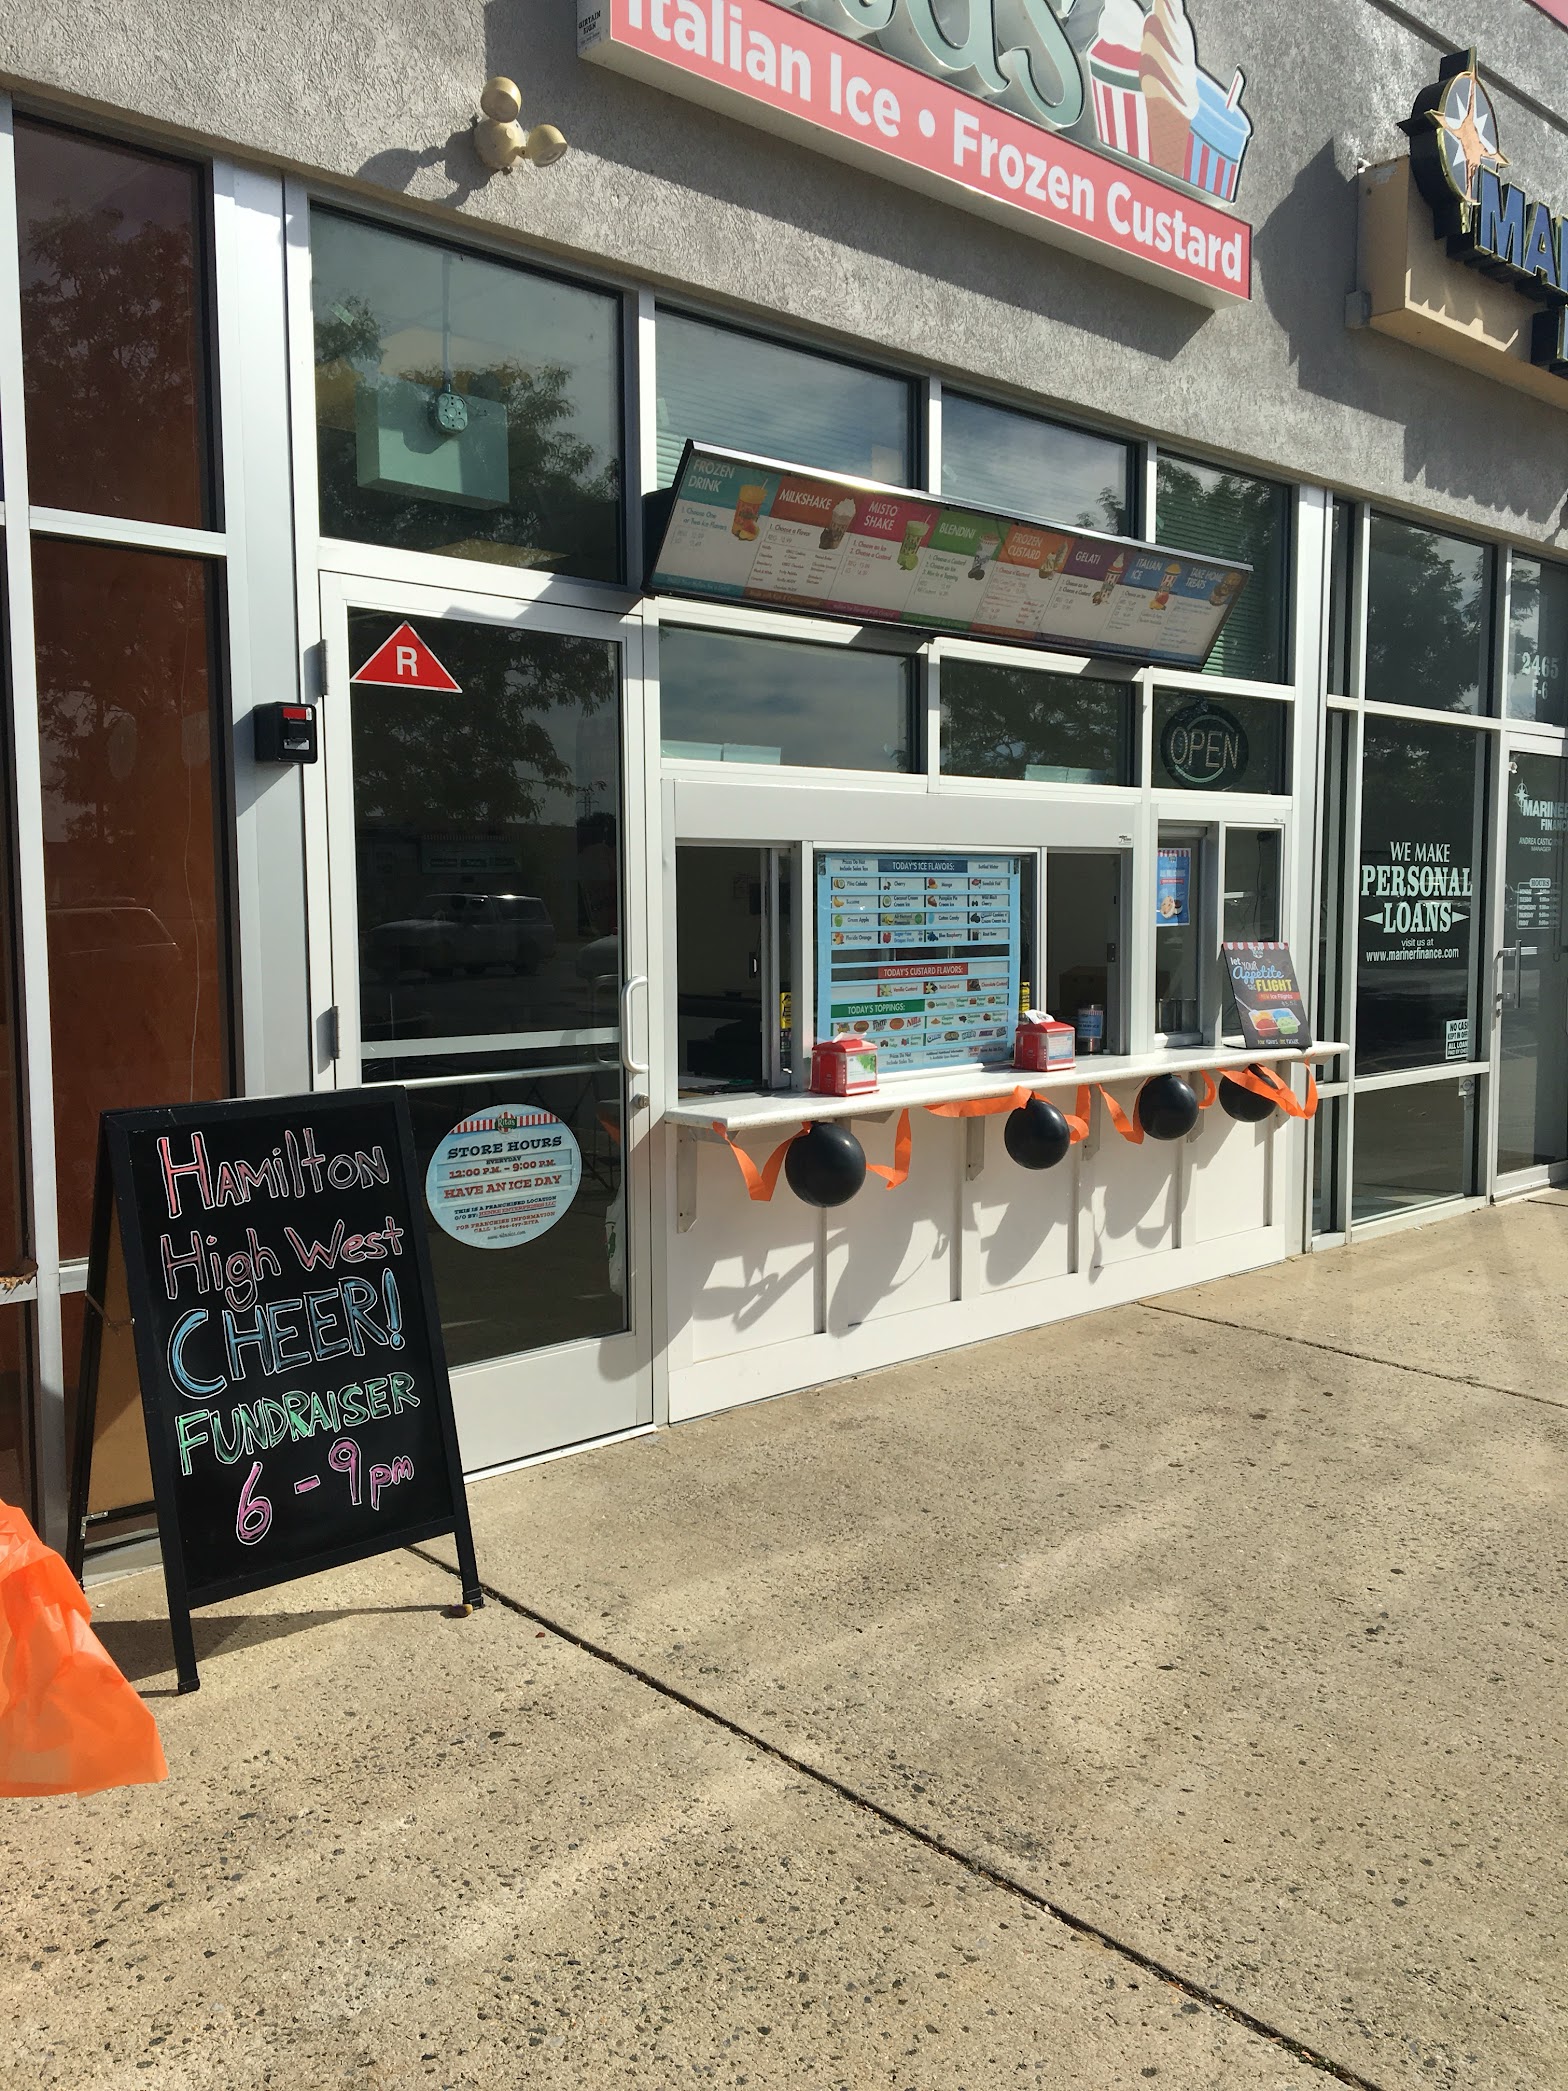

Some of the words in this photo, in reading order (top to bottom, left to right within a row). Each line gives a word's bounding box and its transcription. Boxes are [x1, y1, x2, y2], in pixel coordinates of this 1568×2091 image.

[830, 51, 901, 138] Ice
[953, 108, 1095, 222] Frozen
[1107, 182, 1242, 283] Custard
[693, 459, 735, 479] FROZEN
[687, 475, 722, 493] DRINK
[779, 489, 832, 510] MILKSHAKE
[868, 501, 899, 517] MISTO
[774, 524, 792, 533] Choose
[797, 528, 811, 537] Flavor
[863, 515, 895, 531] SHAKE
[939, 522, 976, 539] BLENDINI
[858, 540, 873, 549] Choose
[1012, 532, 1044, 548] FROZEN
[855, 549, 871, 557] Choose
[875, 552, 892, 561] Custard
[1007, 545, 1041, 560] CUSTARD
[1075, 551, 1102, 565] GELATI
[930, 562, 945, 571] Choose
[932, 555, 947, 564] Choose
[950, 558, 967, 567] Custard
[1136, 558, 1164, 571] ITALIAN
[1130, 569, 1144, 580] ICE
[1190, 567, 1206, 579] TAKE
[1205, 570, 1225, 583] HOME
[1185, 577, 1207, 589] TREATS
[396, 646, 419, 677] R
[1521, 651, 1560, 680] 2465
[1170, 726, 1240, 771] OPEN
[1540, 818, 1568, 832] FINANC
[1518, 836, 1536, 846] ANDREA
[1389, 841, 1412, 861] WE
[1414, 842, 1451, 863] MAKE
[892, 861, 917, 870] TODAY'S
[918, 862, 928, 871] ICE
[928, 862, 955, 871] FLAVORS:
[893, 880, 906, 888] Cherry
[1360, 864, 1473, 897] PERSONAL
[1383, 902, 1452, 933] LOANS
[858, 934, 872, 942] Orange
[1401, 938, 1416, 947] visit
[1416, 939, 1426, 947] us
[1426, 938, 1434, 946] at
[1230, 957, 1241, 966] let
[1366, 947, 1459, 962] www.marinerfinance.com
[883, 967, 909, 977] TODAY'S
[909, 966, 936, 976] CUSTARD
[936, 965, 963, 975] FLAVORS:
[1241, 960, 1259, 971] YOUR
[1232, 965, 1285, 985] Appetite
[1255, 979, 1293, 992] FLIGHT
[847, 1004, 874, 1015] TODAY'S
[875, 1002, 906, 1013] TOPPINGS:
[1449, 1022, 1457, 1032] NO
[1458, 1021, 1468, 1031] CAS
[1456, 1040, 1468, 1049] LOAN
[447, 1143, 503, 1159] STORE
[507, 1136, 562, 1152] HOURS
[486, 1155, 522, 1165] EVERYDAY
[449, 1168, 480, 1179] 12:00
[482, 1166, 501, 1175] P.M.
[512, 1161, 537, 1172] 9:00
[538, 1159, 556, 1168] P.M.
[443, 1185, 484, 1199] HAVE
[485, 1182, 506, 1193] AN
[508, 1179, 532, 1190] ICE
[534, 1174, 562, 1187] DAY
[454, 1207, 471, 1215] THIS
[485, 1200, 526, 1211] FRANCHISED
[526, 1195, 557, 1204] LOCATION
[470, 1217, 510, 1228] FRANCHISE
[510, 1211, 556, 1223] INFORMATION
[159, 1228, 281, 1312] High
[284, 1216, 405, 1272] West
[166, 1268, 406, 1400] CHEER!
[174, 1371, 421, 1476] FUNDRAISER
[235, 1461, 273, 1546] 6
